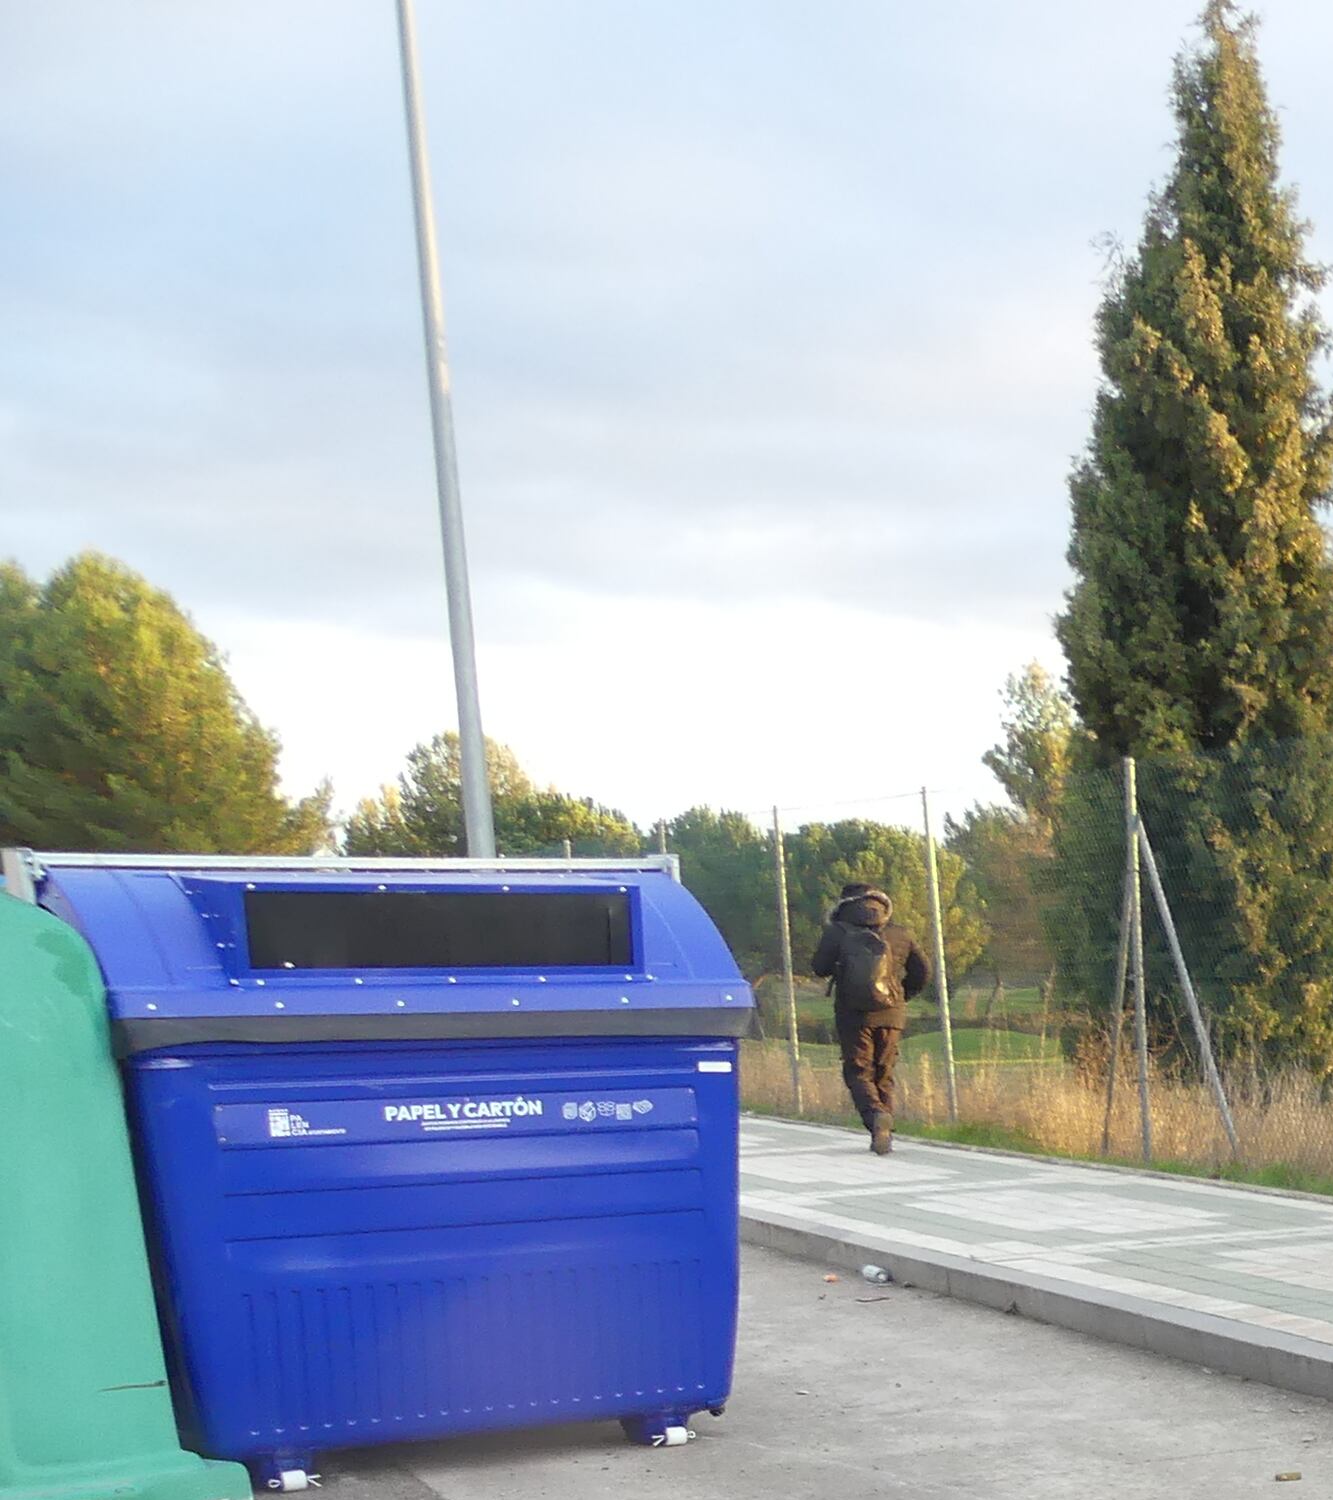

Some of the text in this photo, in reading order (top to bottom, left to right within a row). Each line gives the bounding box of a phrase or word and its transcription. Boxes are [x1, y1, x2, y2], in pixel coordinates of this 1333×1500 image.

[384, 1104, 447, 1122] PAPEL
[448, 1103, 462, 1119] Y
[462, 1096, 543, 1118] CARTÓN
